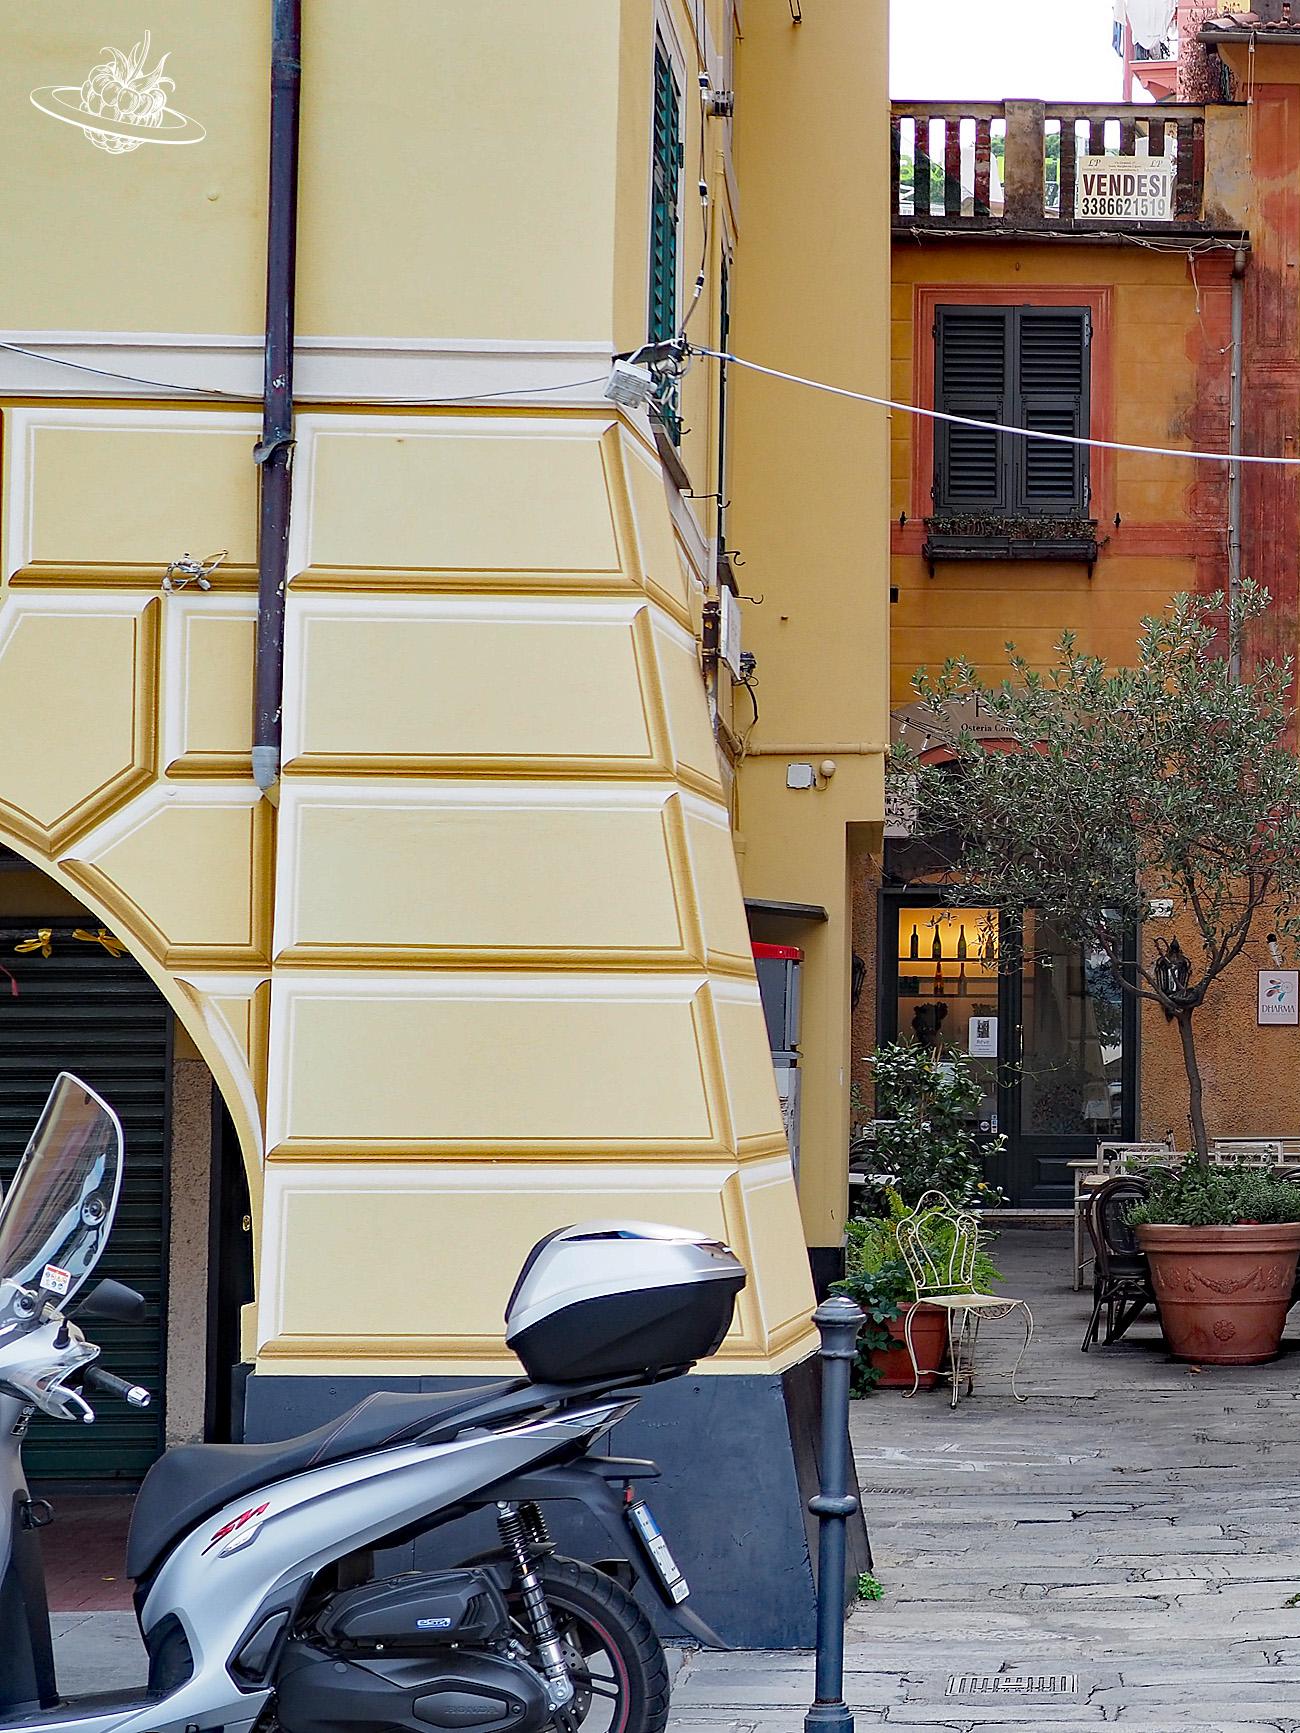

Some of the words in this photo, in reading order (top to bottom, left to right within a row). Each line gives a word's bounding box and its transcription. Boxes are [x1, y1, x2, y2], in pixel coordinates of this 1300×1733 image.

[1082, 174, 1167, 197] VENDESI
[1082, 198, 1165, 216] 3386621519
[961, 723, 992, 732] Osteria
[1261, 1004, 1296, 1013] DHARMA
